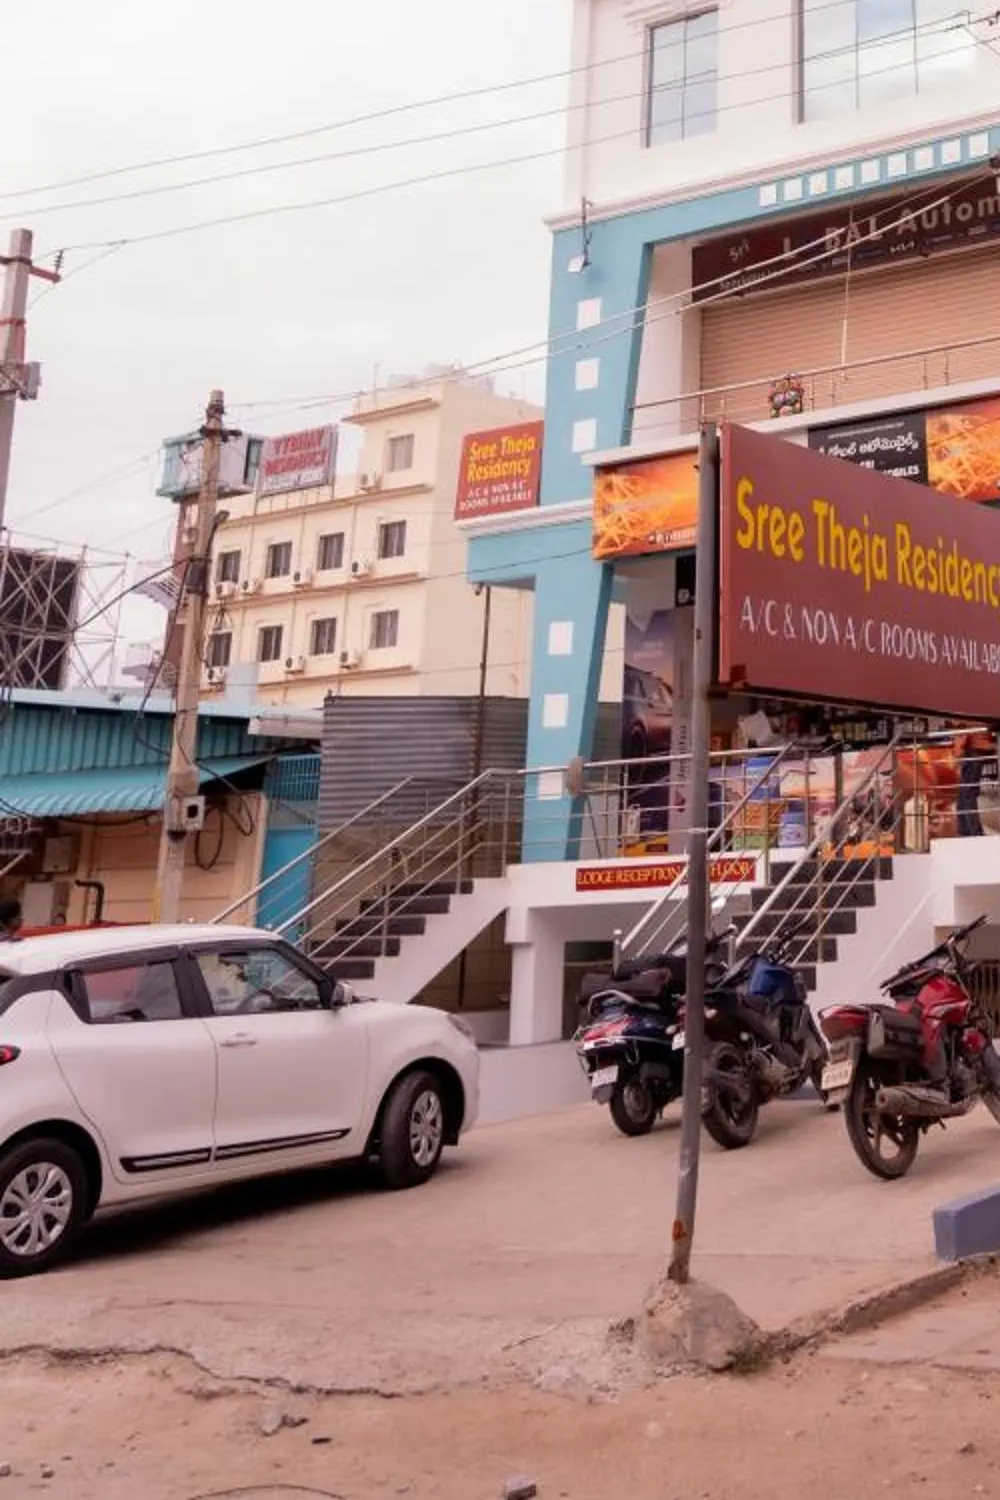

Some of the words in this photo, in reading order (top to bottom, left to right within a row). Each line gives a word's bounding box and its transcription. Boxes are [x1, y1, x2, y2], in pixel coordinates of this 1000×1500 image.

[468, 441, 498, 461] Sree
[501, 434, 536, 457] Theja
[467, 456, 531, 484] Residency
[735, 475, 805, 563] Sree
[812, 498, 889, 591] Theja
[782, 604, 796, 640] &
[801, 607, 840, 646] NON
[880, 621, 938, 664] ROOMS
[577, 870, 617, 885] LODGE
[616, 864, 682, 883] RECEPTION
